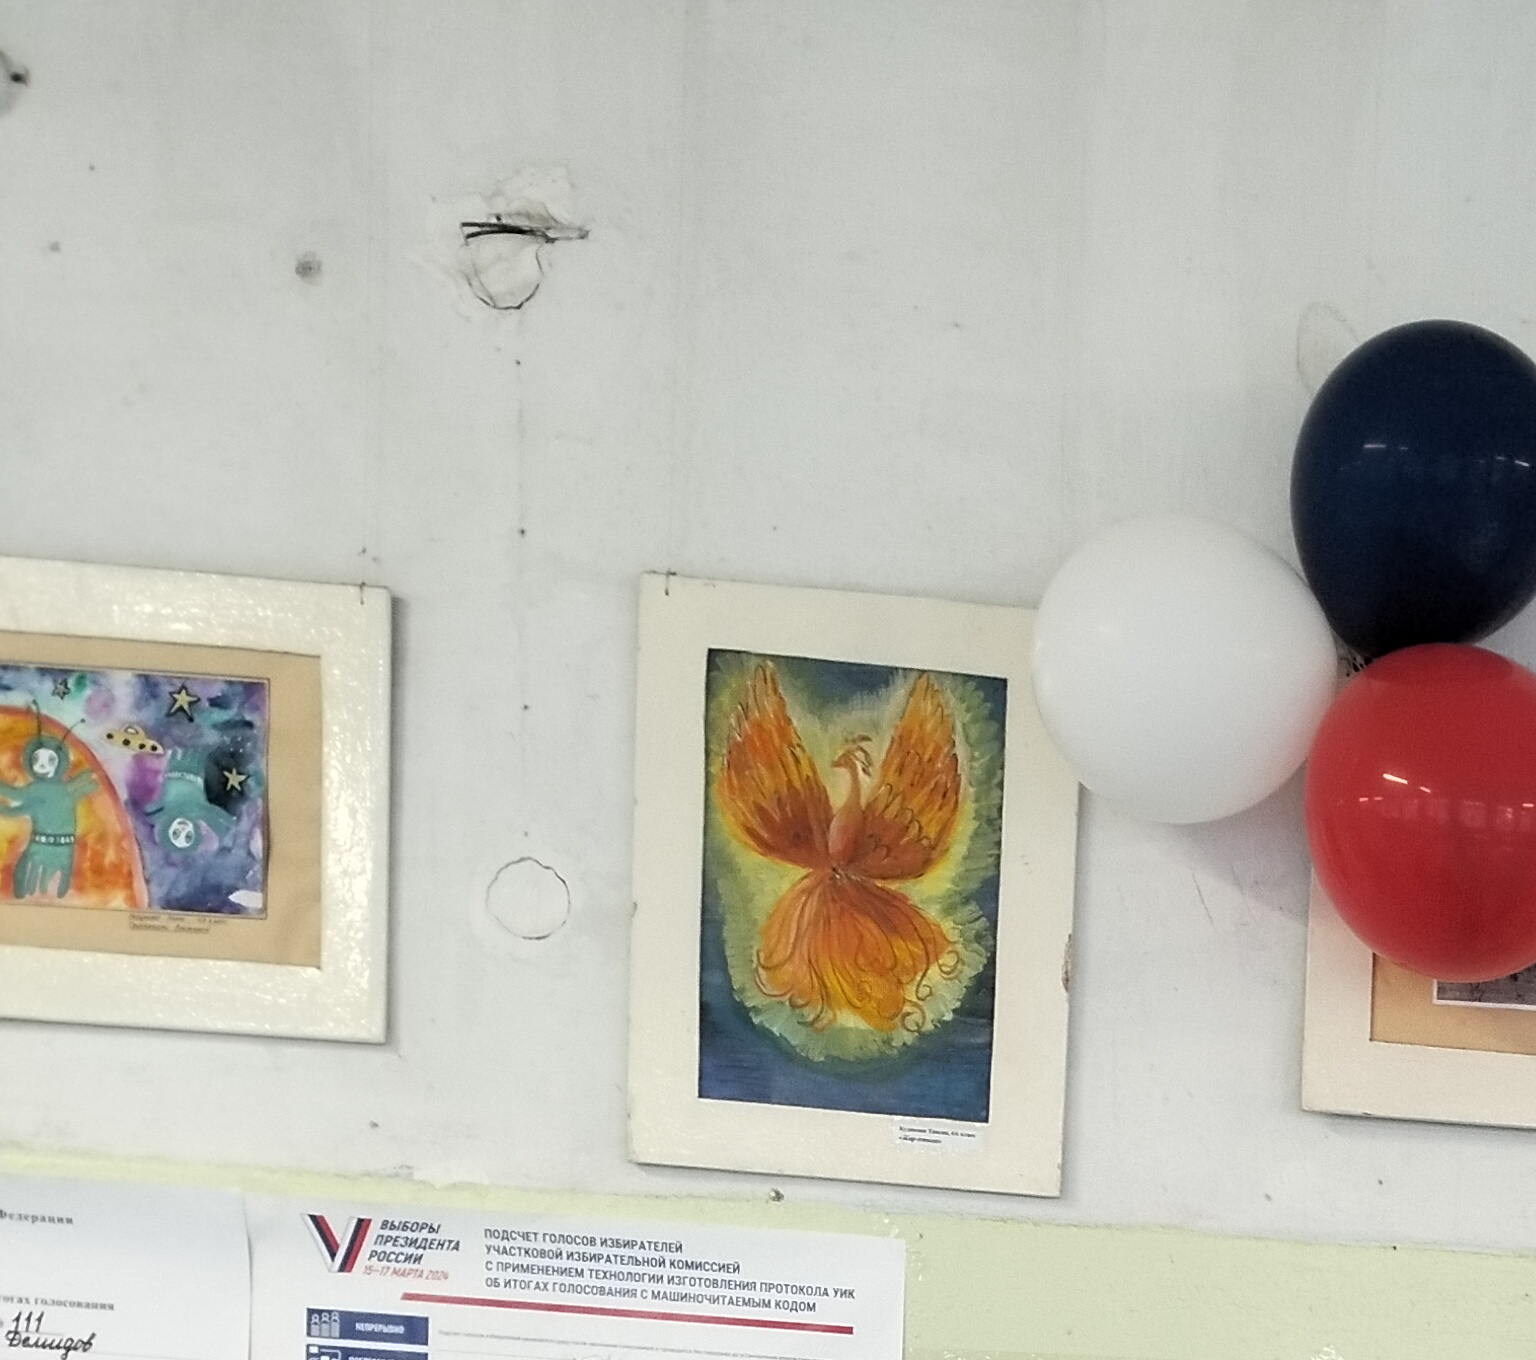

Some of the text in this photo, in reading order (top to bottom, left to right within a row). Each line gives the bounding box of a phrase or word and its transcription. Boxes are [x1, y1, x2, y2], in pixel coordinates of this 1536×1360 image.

[380, 1220, 441, 1234] ВЫБОРЫ
[374, 1235, 460, 1251] ПРЕЗИДЕНТА
[484, 1228, 682, 1253] ПОДСЧЕТ ГОЛОСОВ ИЗБИРАТЕЛЕЙ
[368, 1250, 423, 1265] РОССИИ
[485, 1244, 740, 1274] УЧАСТКОВОЙ ИЗБИРАТЕЛЬНОЙ КОМИССИЕЙ
[391, 1268, 424, 1279] МАРТА
[485, 1261, 855, 1299] С ПРИМЕНЕНИЕМ ТЕХНОЛОГИИ ИЗГОТОВЛЕНИЯ ПРОТОКОЛА УИК
[485, 1277, 816, 1313] ОБ ИТОГАХ ГОЛОСОВАНИЯ С МАШИНОЧИТАЕМЫМ КОДОМ
[12, 1311, 44, 1333] 111
